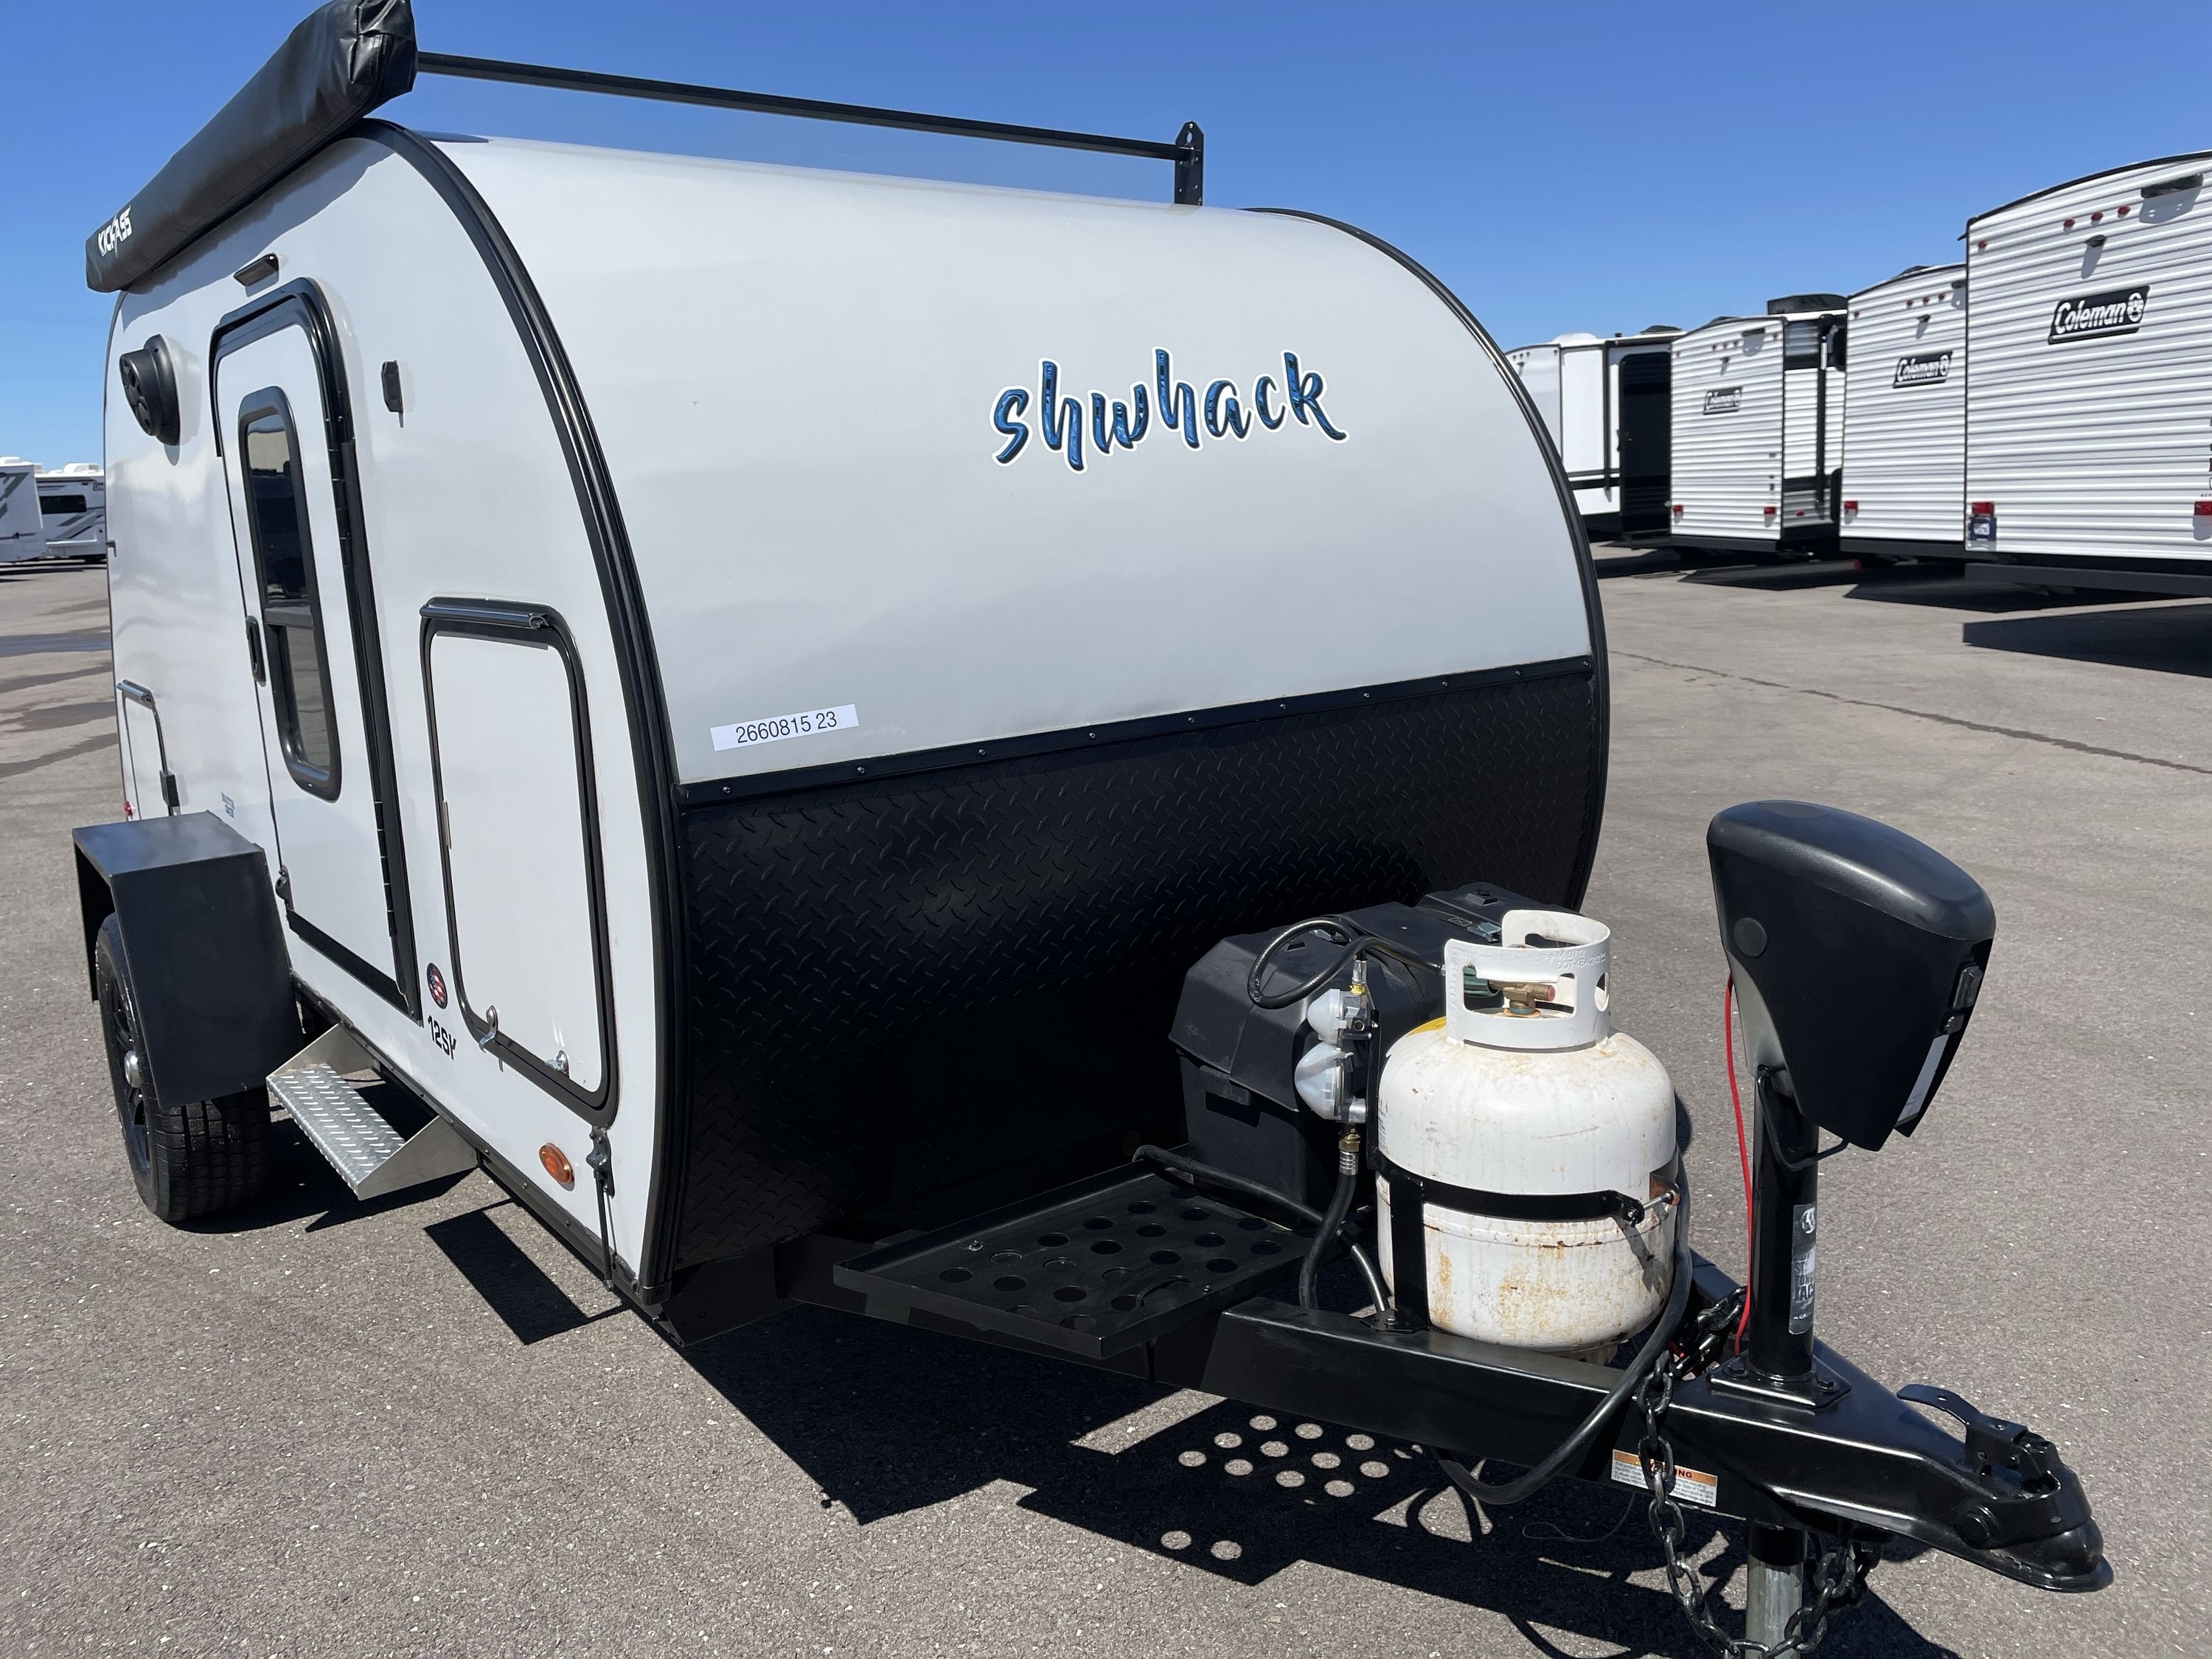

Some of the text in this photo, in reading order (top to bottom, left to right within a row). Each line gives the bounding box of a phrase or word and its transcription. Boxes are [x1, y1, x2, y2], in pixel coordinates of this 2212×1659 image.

[2054, 299, 2126, 334] Coleman
[1896, 358, 1940, 381] Coleman
[990, 347, 1349, 473] shwhack
[736, 711, 838, 743] 2660815 23
[427, 1015, 457, 1060] 12SY
